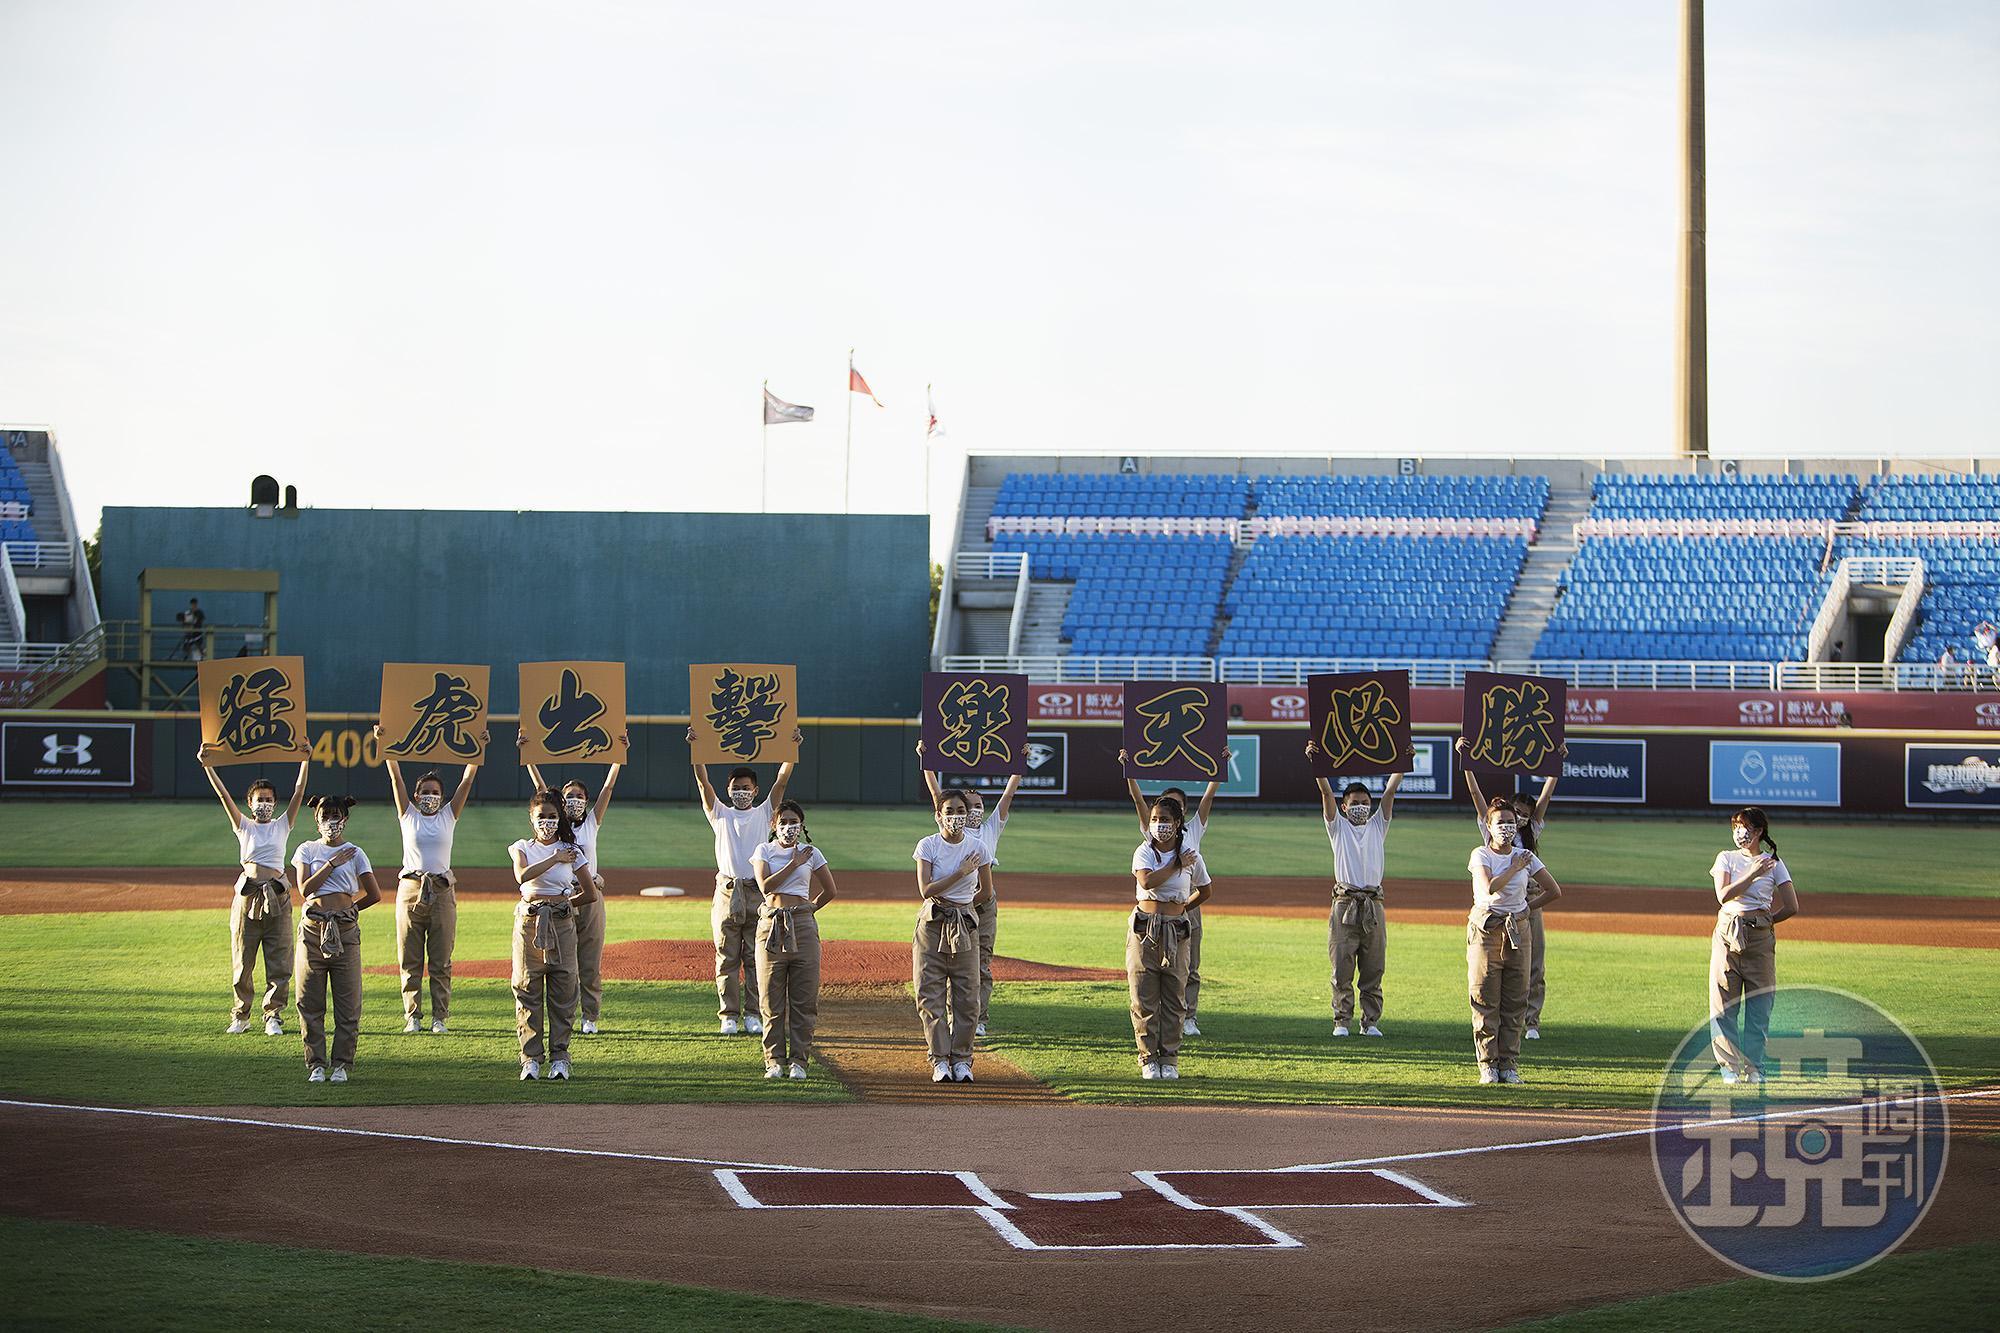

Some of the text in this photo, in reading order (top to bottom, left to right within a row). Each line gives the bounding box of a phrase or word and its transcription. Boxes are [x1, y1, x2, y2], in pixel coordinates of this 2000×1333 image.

[1121, 457, 1137, 472] A
[1401, 459, 1414, 474] B
[216, 666, 787, 761] 猛 虎 出 擊
[937, 679, 1555, 776] 樂 天 必 勝
[311, 729, 384, 768] 400
[1562, 762, 1630, 779] Electrolux
